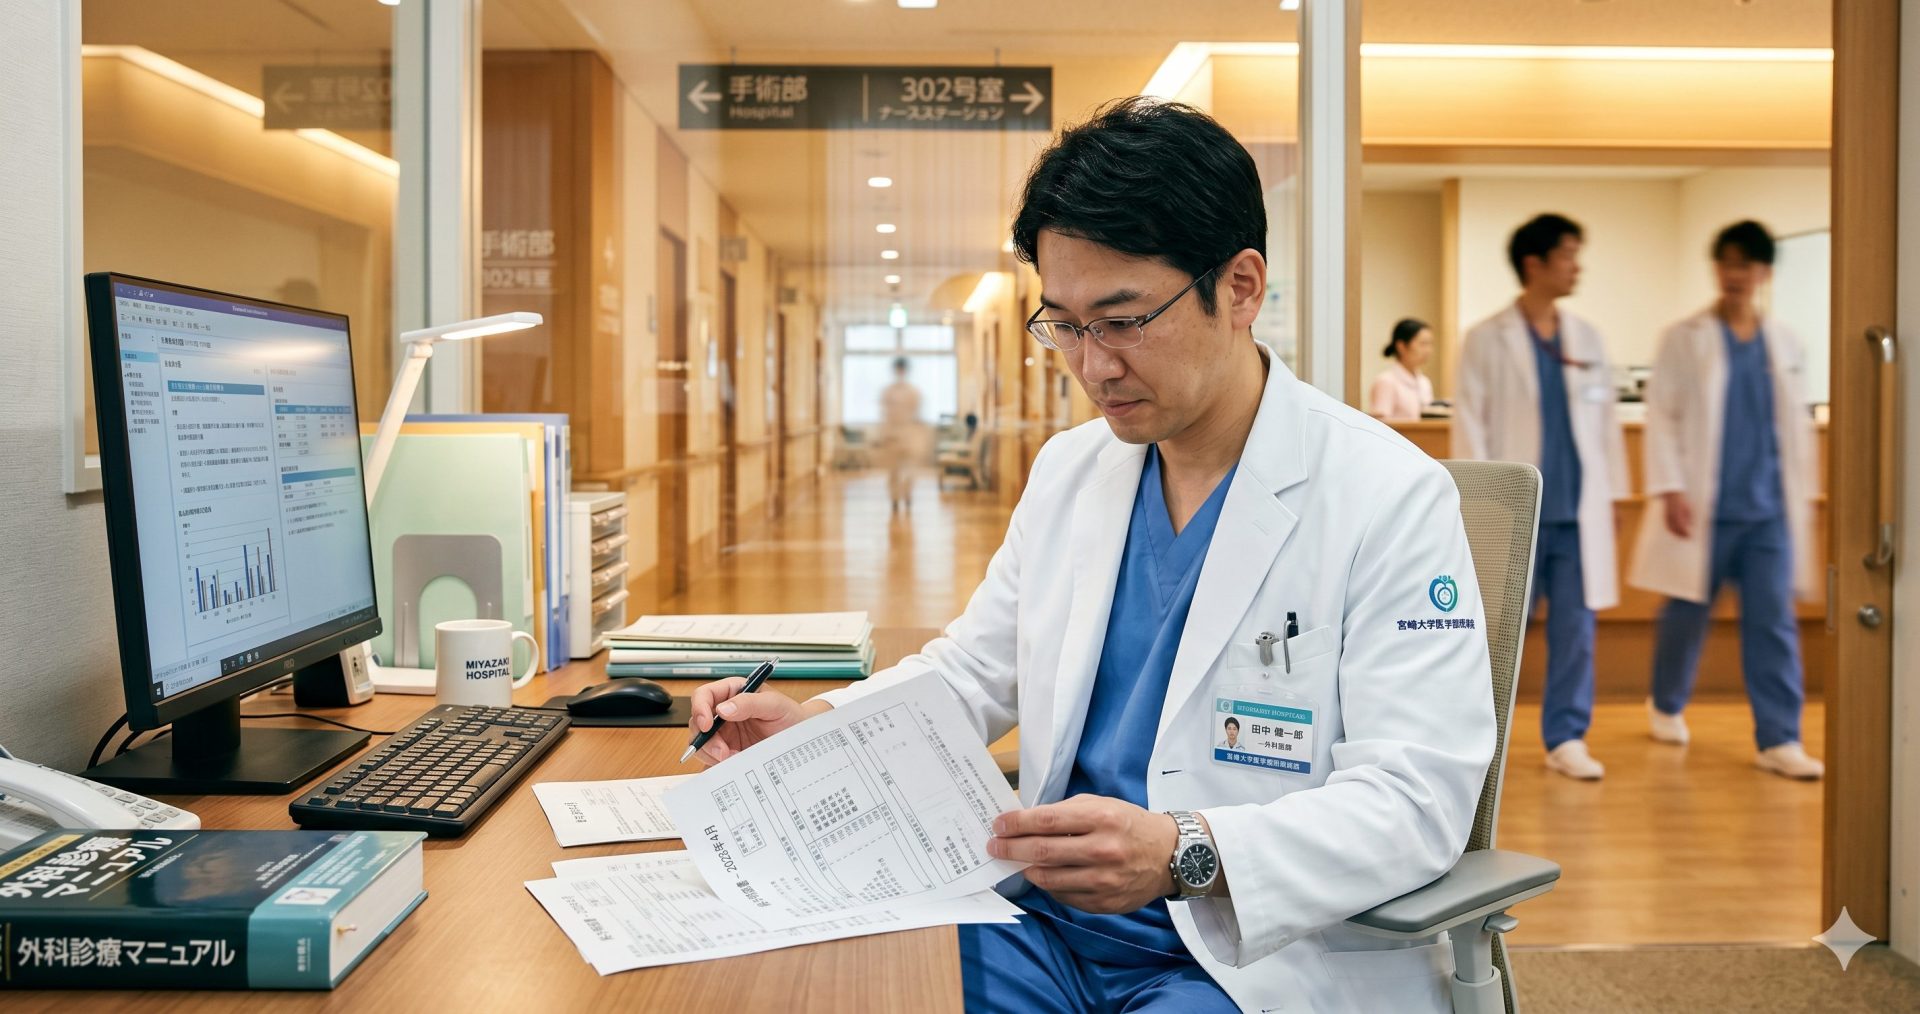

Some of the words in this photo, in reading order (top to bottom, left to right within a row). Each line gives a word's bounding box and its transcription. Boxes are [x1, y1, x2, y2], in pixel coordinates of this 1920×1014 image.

[729, 75, 808, 102] 手術部
[901, 76, 1005, 103] 302号室
[730, 105, 794, 120] Hospital
[878, 105, 1004, 121] ナースステーション
[466, 657, 509, 669] MIYAZAKI
[466, 668, 510, 680] HOSPITAL
[1251, 724, 1271, 736] 田中
[1274, 726, 1304, 740] 健一郎
[0, 836, 133, 898] 外科診療
[42, 836, 173, 898] マニュアル
[18, 936, 236, 968] 外科診療マニュアル
